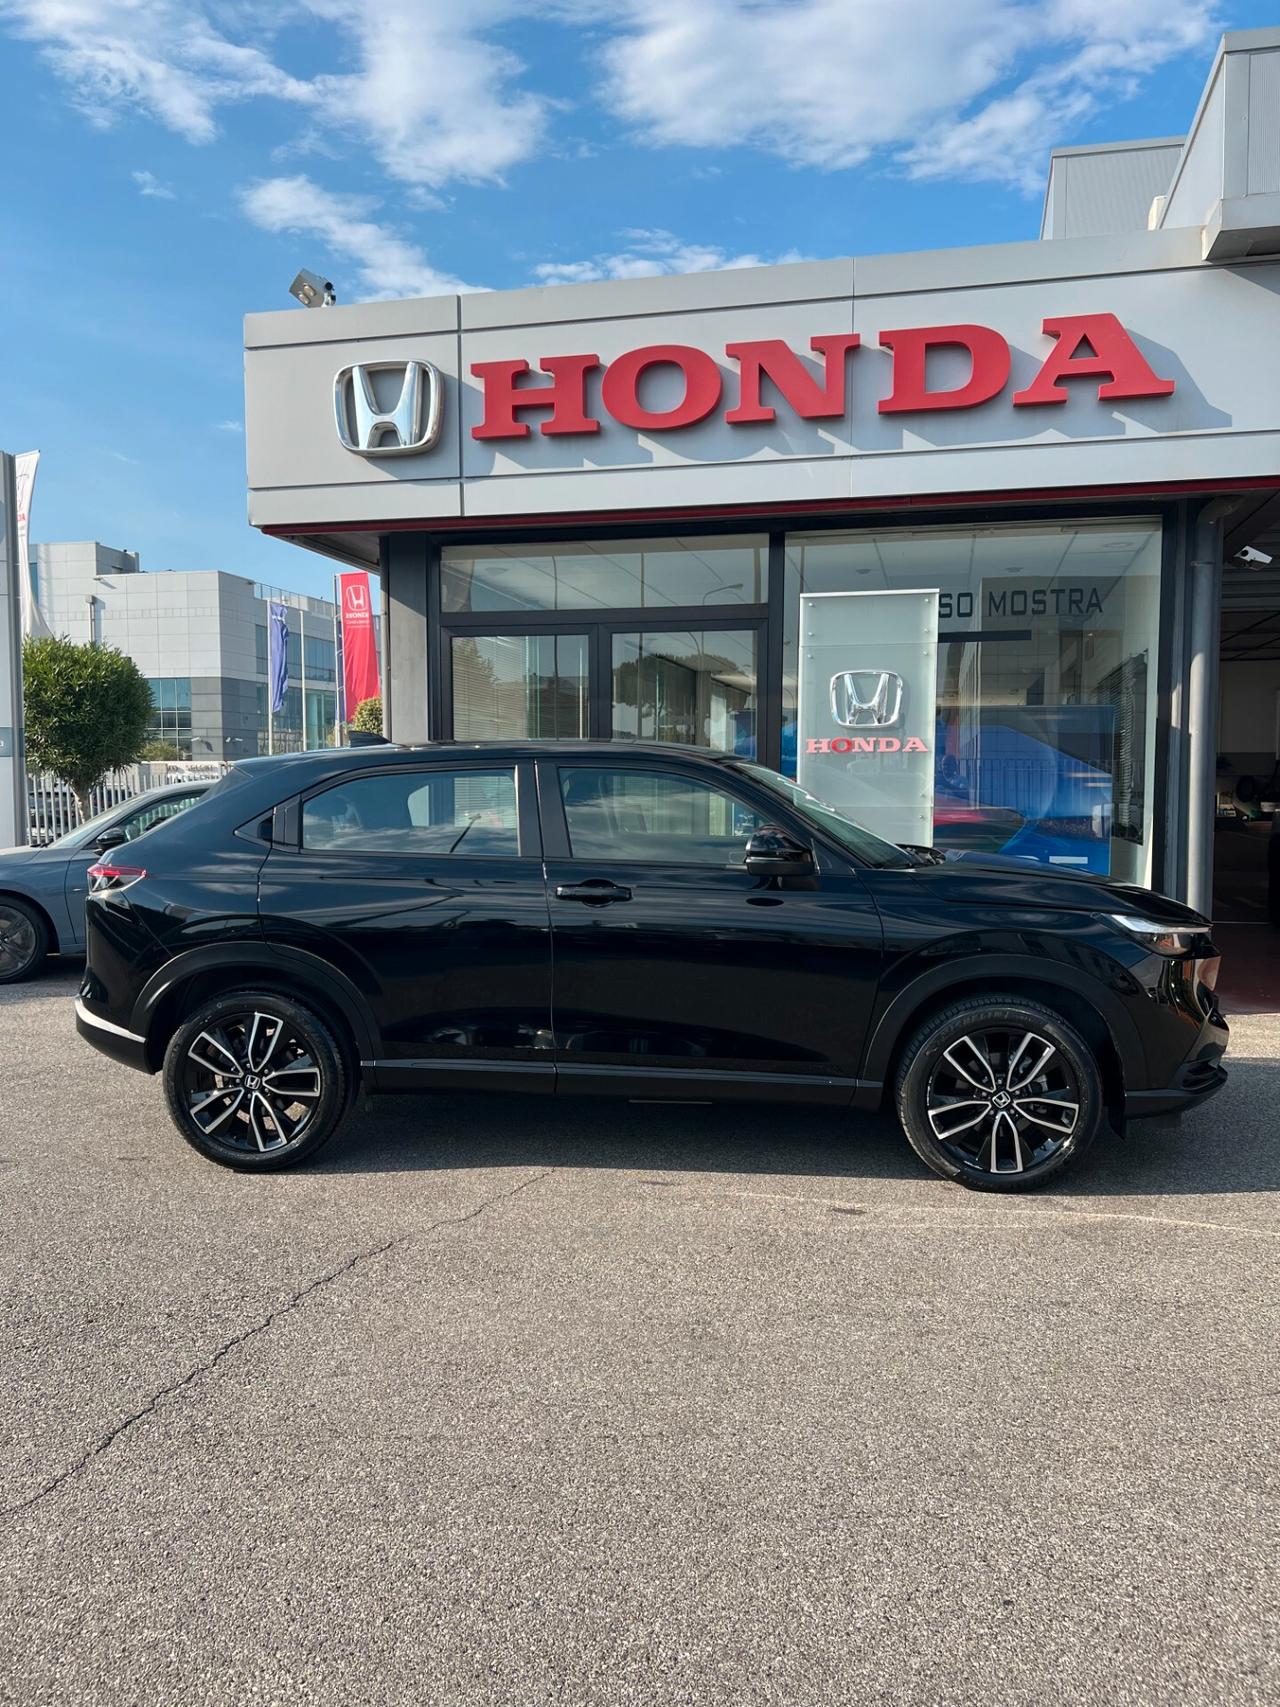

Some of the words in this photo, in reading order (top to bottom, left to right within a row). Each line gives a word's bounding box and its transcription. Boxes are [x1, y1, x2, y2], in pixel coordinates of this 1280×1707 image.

[470, 312, 1176, 441] HONDA
[988, 588, 1104, 616] MOSTRA
[806, 736, 929, 753] HONDA
